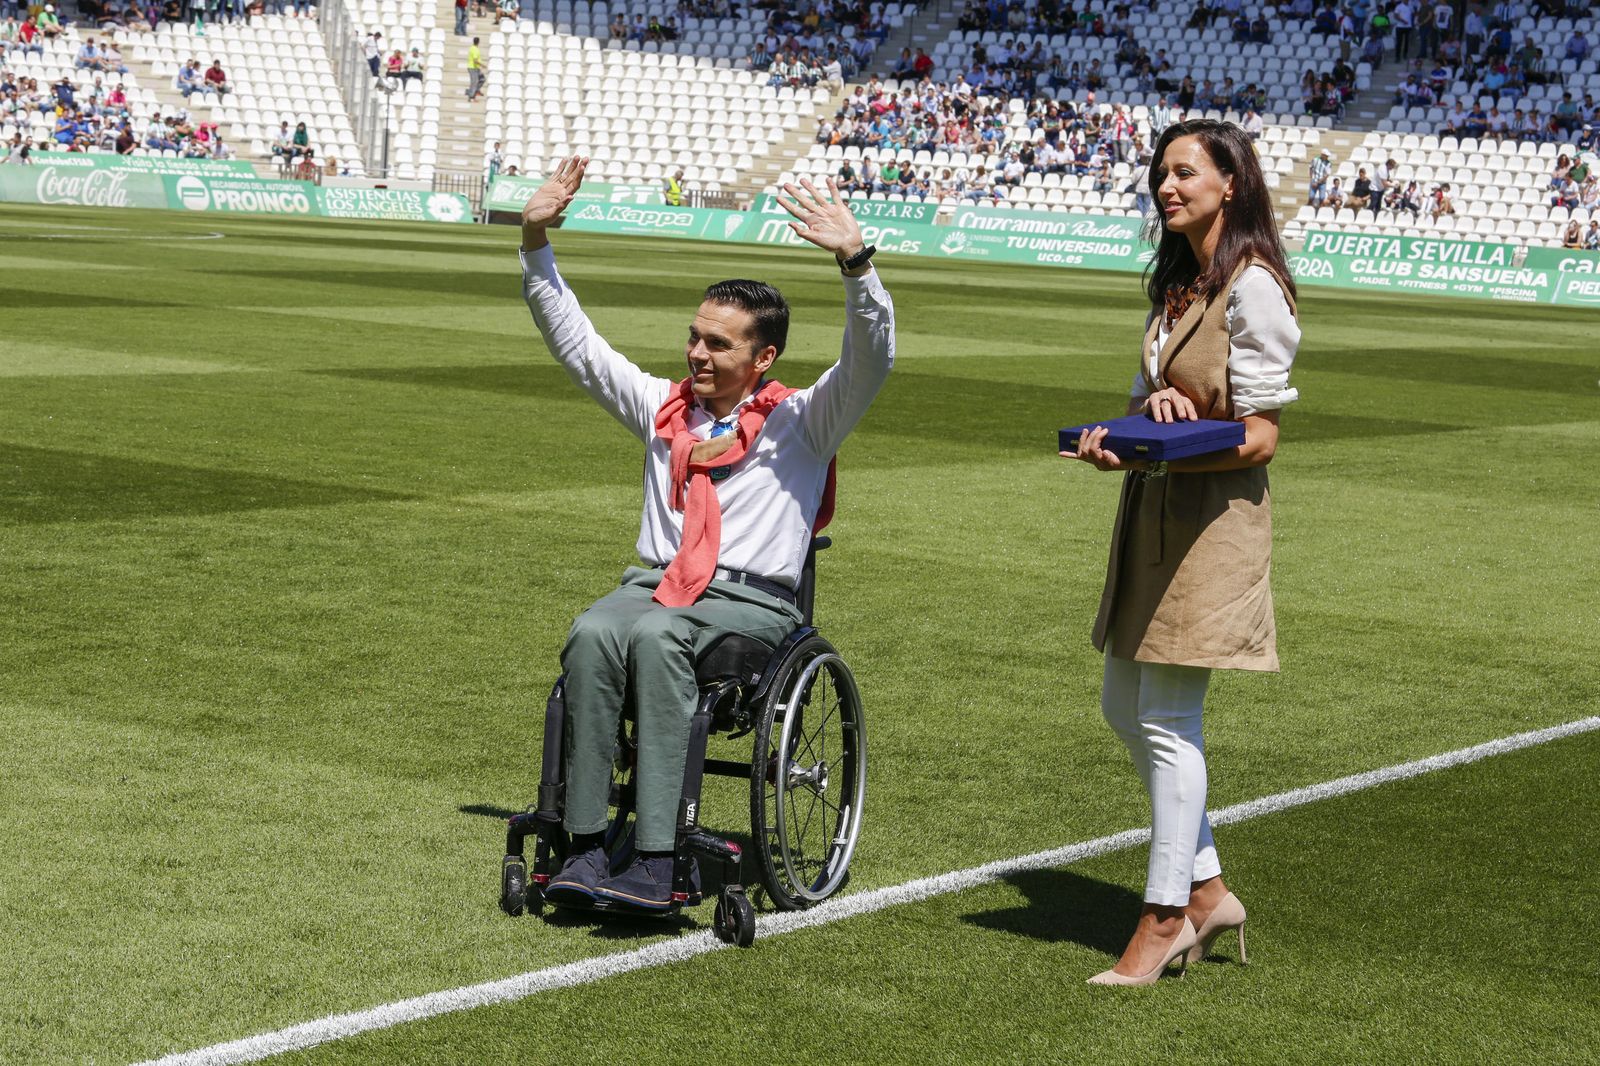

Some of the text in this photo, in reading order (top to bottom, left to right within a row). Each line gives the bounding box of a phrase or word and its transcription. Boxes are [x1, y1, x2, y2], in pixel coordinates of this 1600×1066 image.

[212, 189, 309, 213] PROINCO
[325, 187, 420, 203] ASISTENCIAS
[326, 199, 424, 213] LOS ANGELES
[328, 210, 378, 219] SERVICIOS
[607, 205, 695, 227] Kappa
[1071, 220, 1135, 239] Radler
[1007, 236, 1132, 257] TU UNIVERSIDAD
[1308, 233, 1505, 266] PUERTA SEVILLA
[1037, 252, 1083, 264] uco.es
[1350, 259, 1549, 288] CLUB SANSUEÑA
[1358, 277, 1537, 297] PADEL FITNESS GYM PISCINA
[685, 803, 696, 826] TIGA
